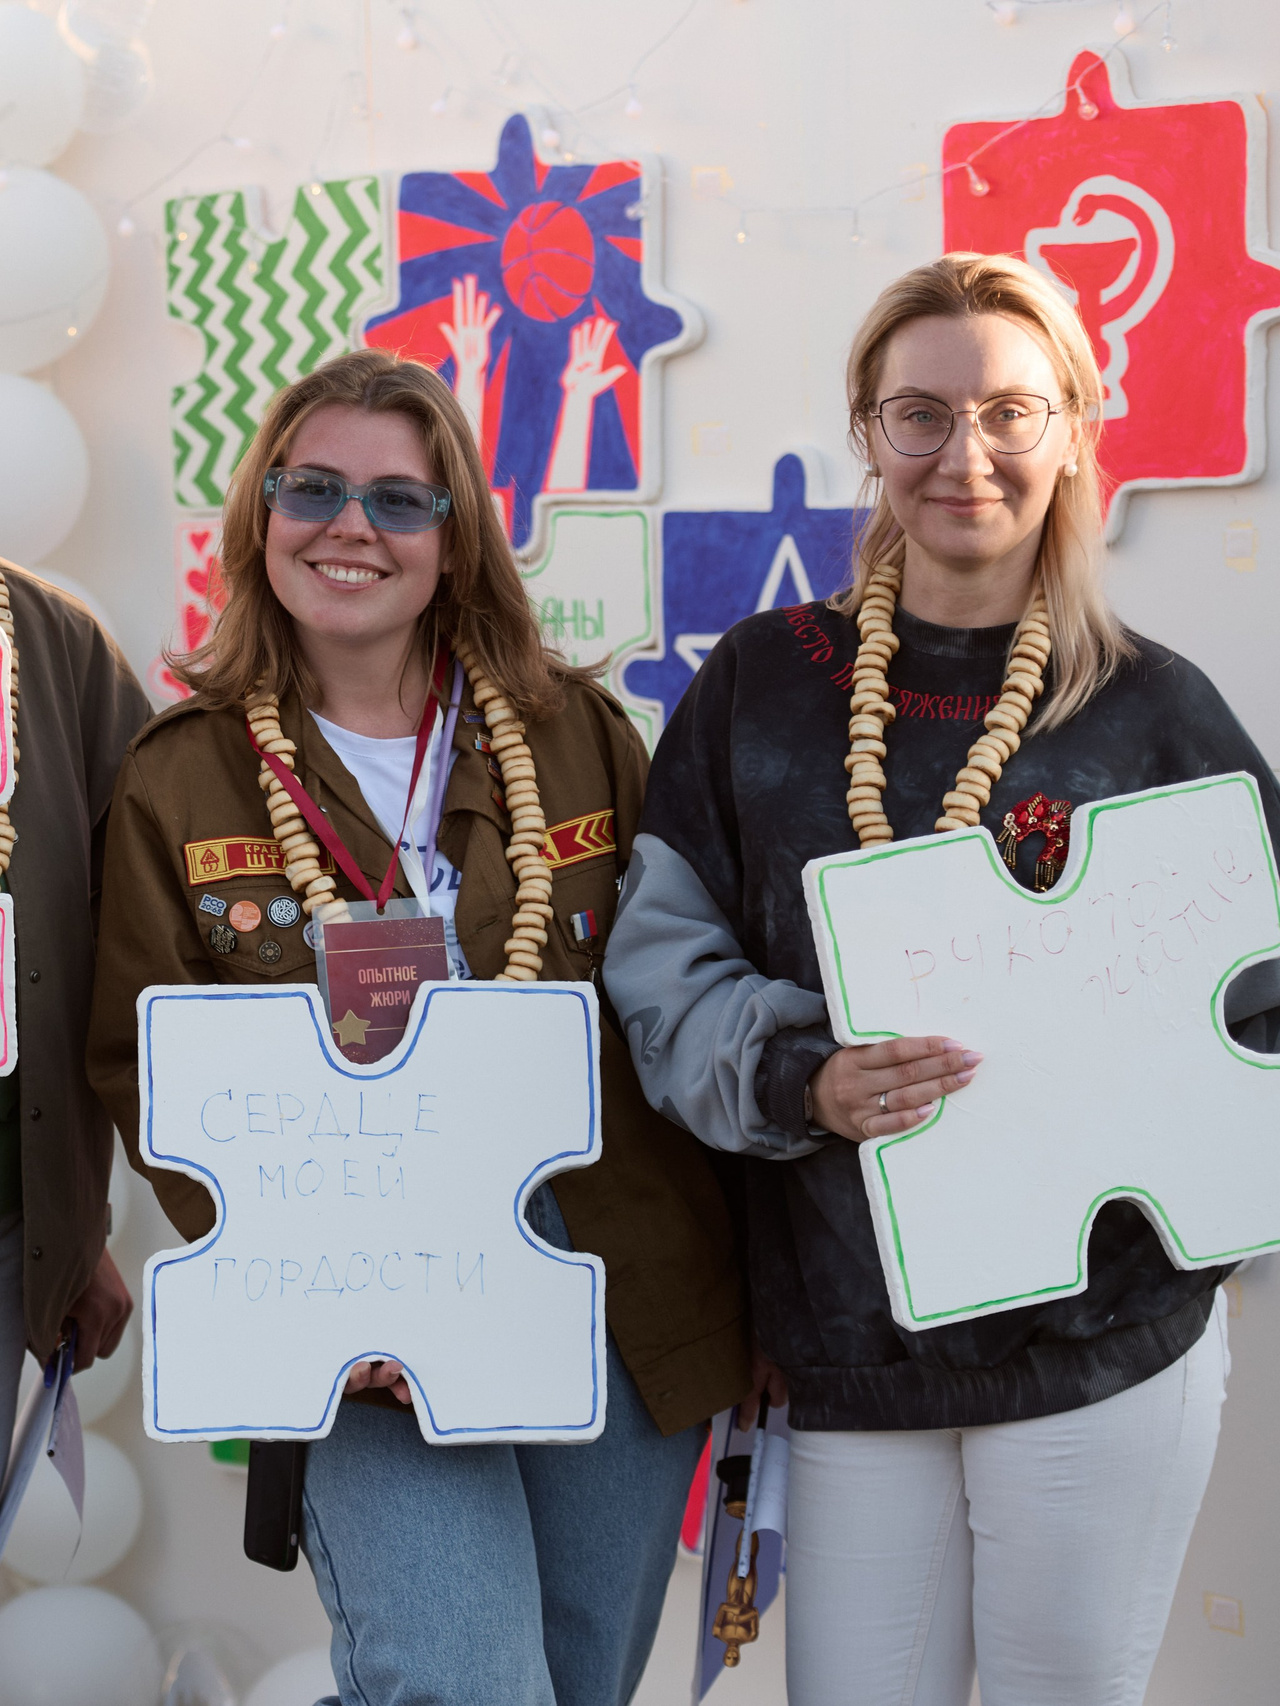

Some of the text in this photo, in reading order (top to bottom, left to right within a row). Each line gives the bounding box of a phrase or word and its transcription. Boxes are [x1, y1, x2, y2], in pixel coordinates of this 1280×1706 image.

[538, 596, 605, 641] АНЫ
[244, 844, 287, 855] КРАЕВ
[358, 965, 419, 985] ОПЫТНОЕ
[369, 989, 412, 1008] ЖЮРИ
[200, 1088, 440, 1144] СЕРДЦЕ
[258, 1145, 406, 1200] МОЕЙ
[211, 1250, 485, 1302] ГОРДОСТИ
